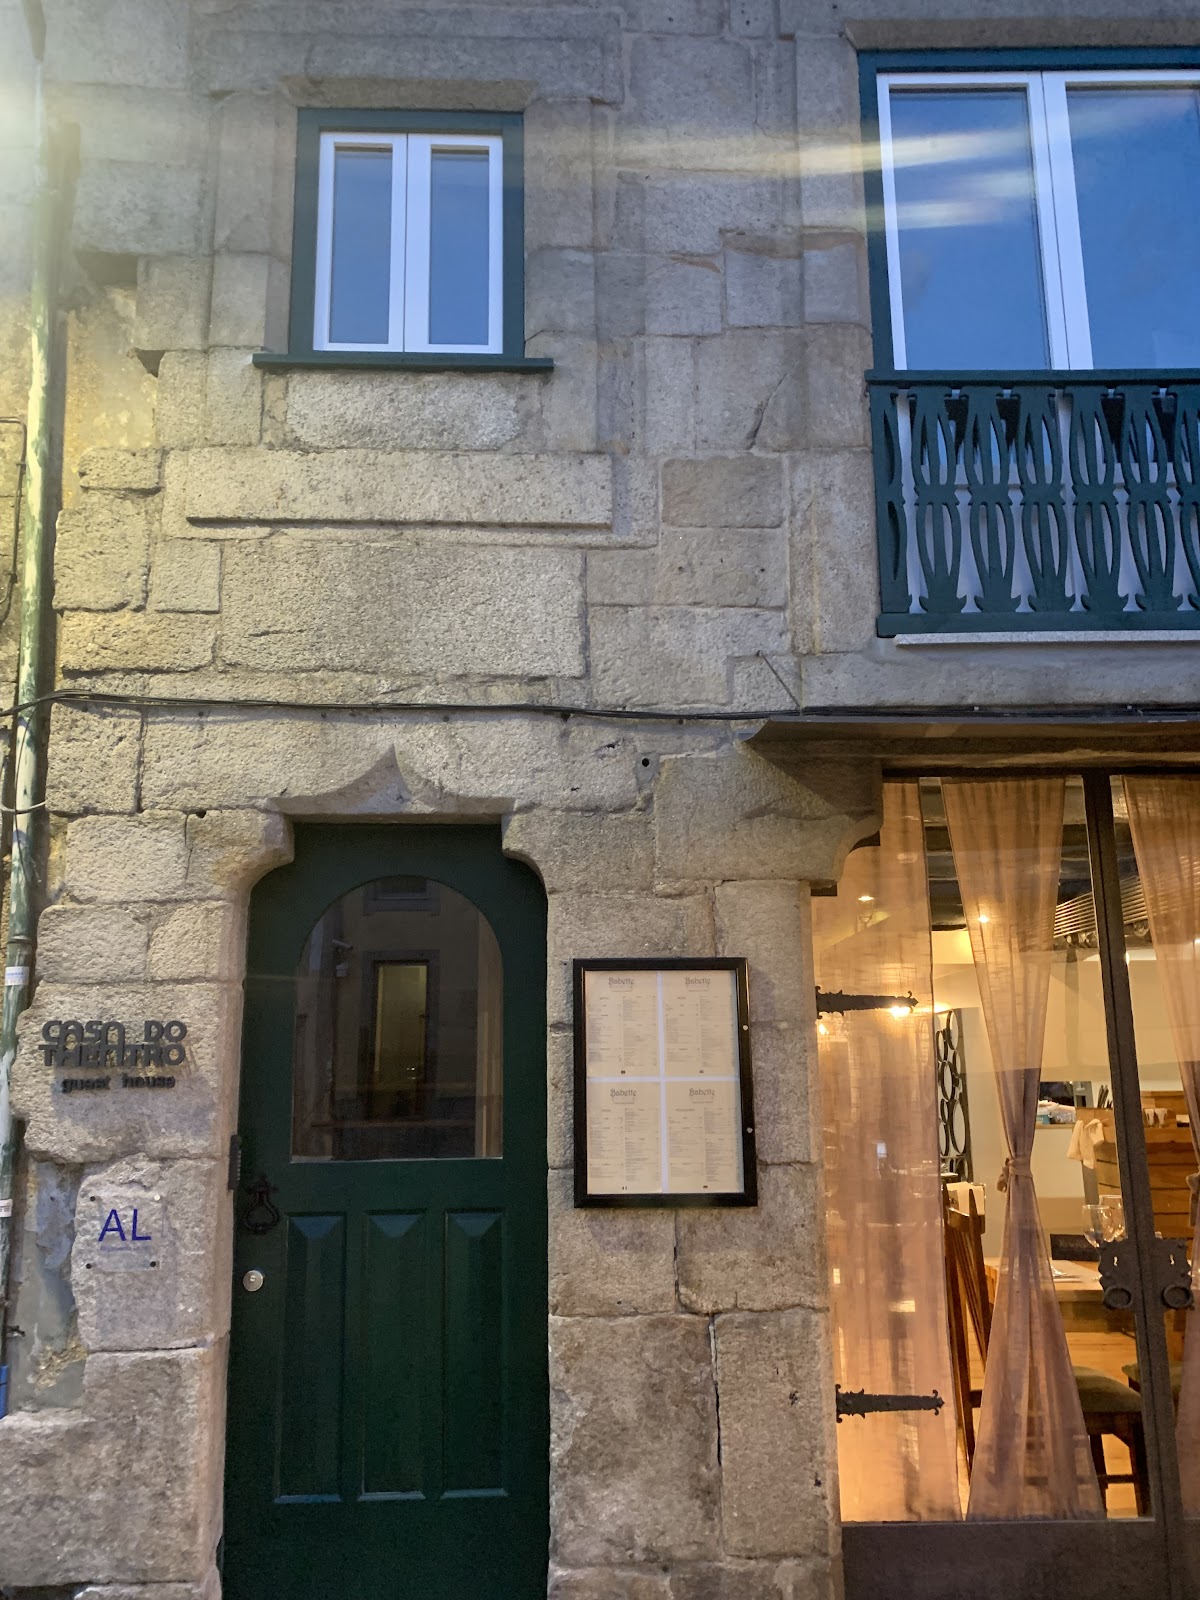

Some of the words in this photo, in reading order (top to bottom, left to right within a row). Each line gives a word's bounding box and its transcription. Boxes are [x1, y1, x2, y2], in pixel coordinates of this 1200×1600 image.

[42, 1020, 125, 1045] CASA
[144, 1020, 187, 1042] DO
[62, 1075, 111, 1093] guest
[122, 1073, 176, 1088] house
[98, 1208, 151, 1242] AL
